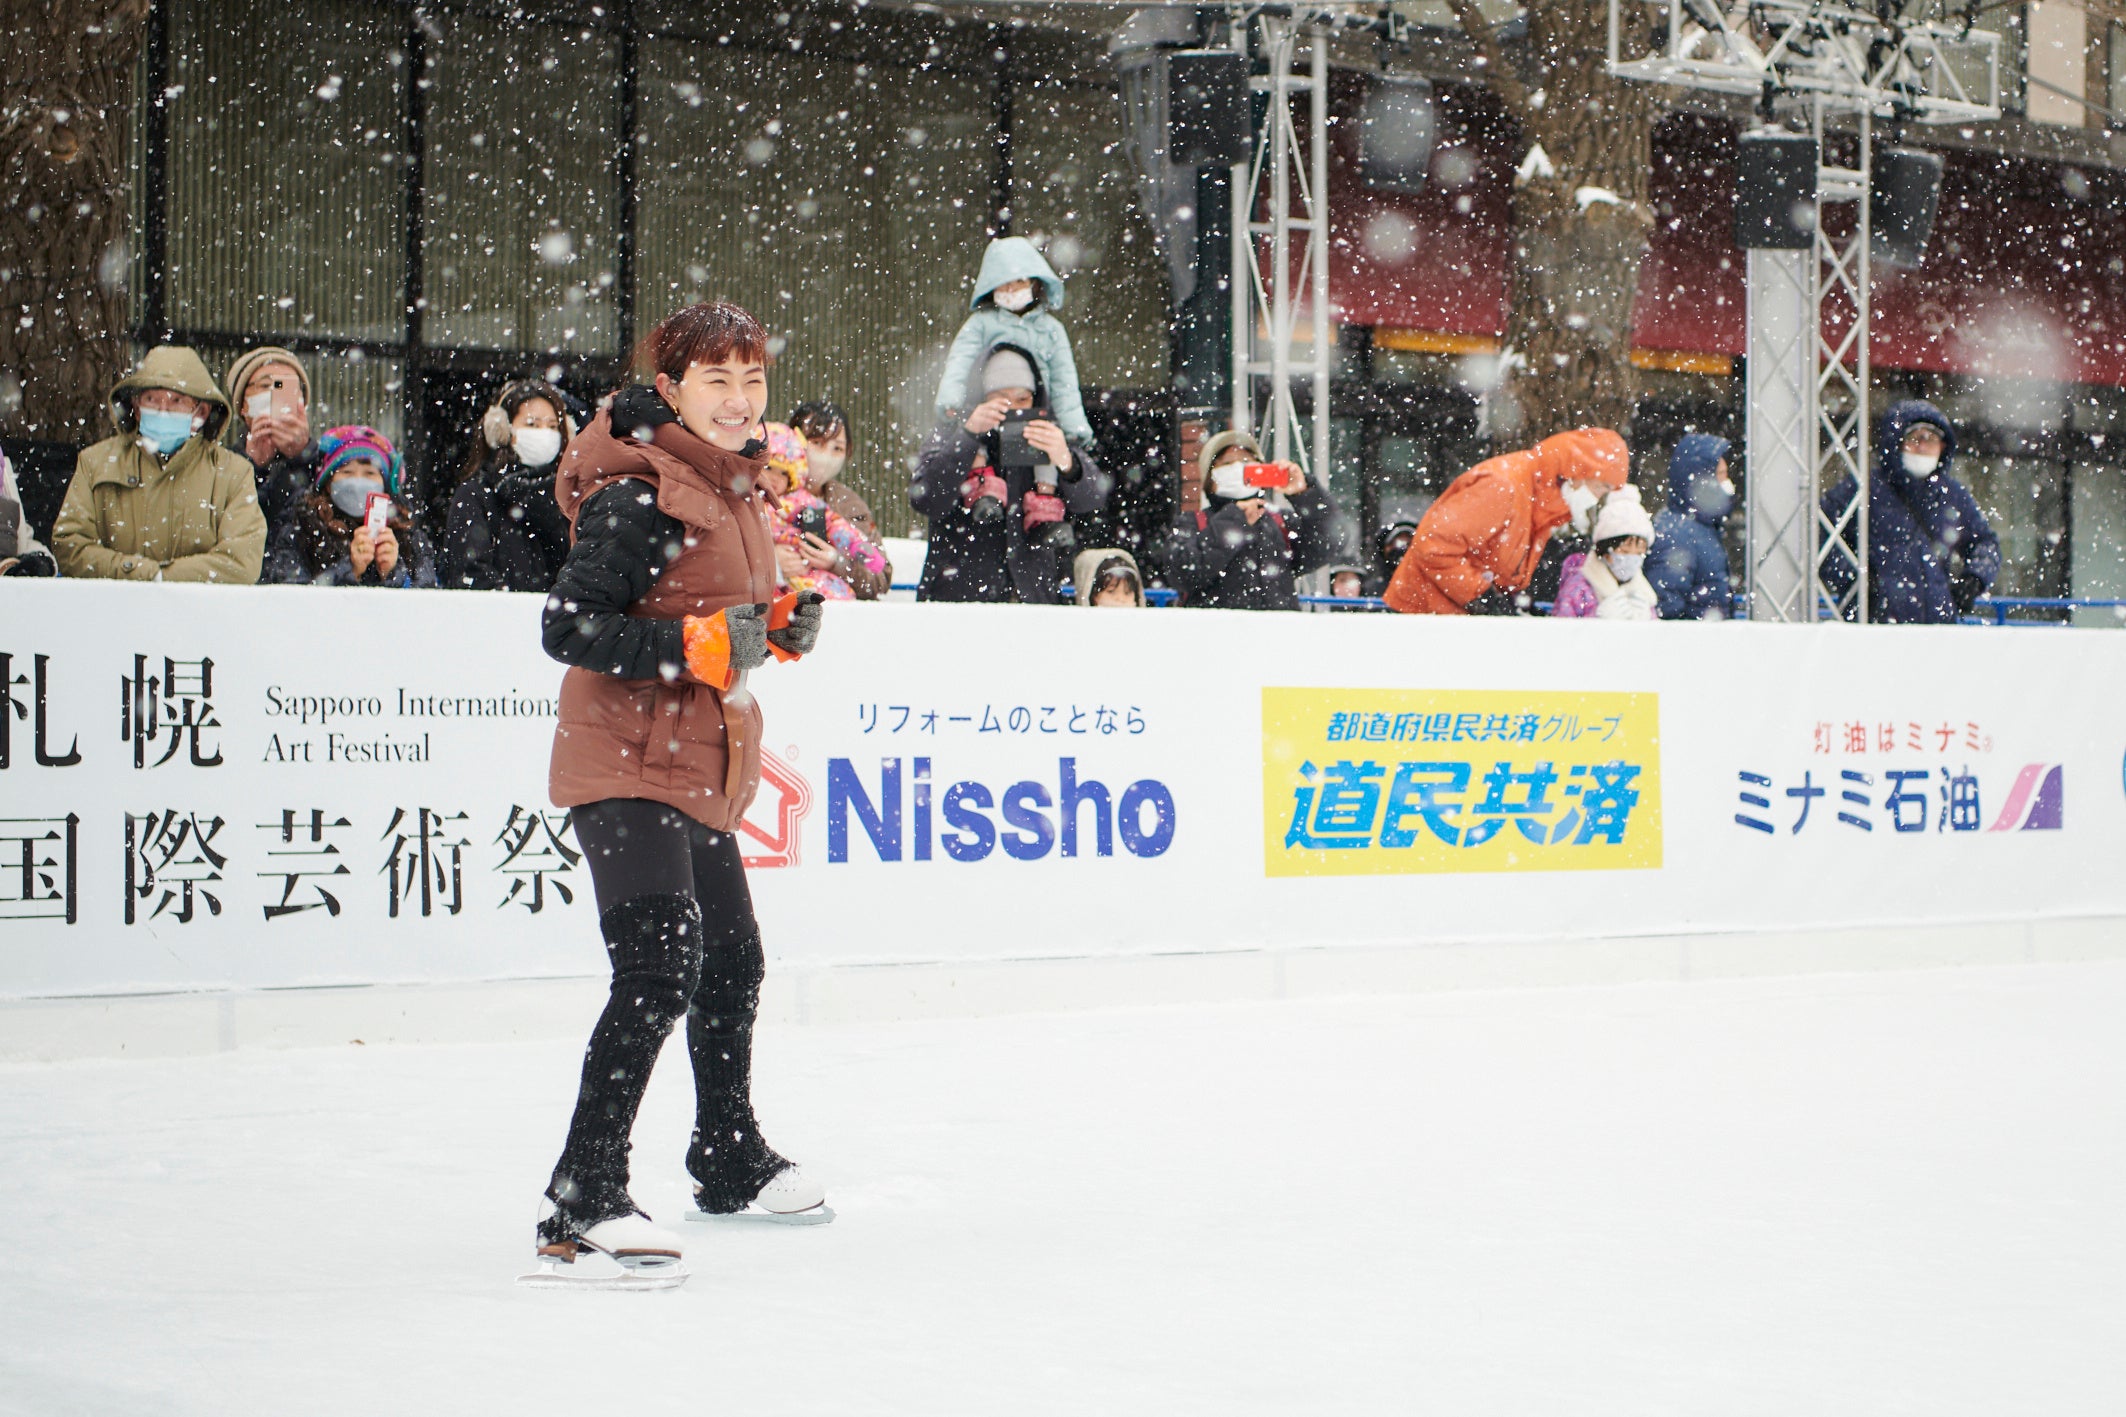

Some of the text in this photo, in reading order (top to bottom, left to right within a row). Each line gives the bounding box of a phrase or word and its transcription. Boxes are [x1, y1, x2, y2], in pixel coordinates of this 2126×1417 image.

[0, 652, 224, 770] 札幌
[265, 685, 382, 724] Sapporo
[859, 704, 1146, 735] リフォームのことなら
[1327, 711, 1623, 743] 都道府県民共済グループ
[263, 732, 430, 763] Art Festival
[1814, 720, 1980, 754] 灯油はミナミ
[827, 756, 1176, 863] Nissho
[1284, 760, 1641, 850] 道民共済
[1735, 765, 1981, 835] ミナミ石油
[0, 804, 583, 925] 国際芸術祭
